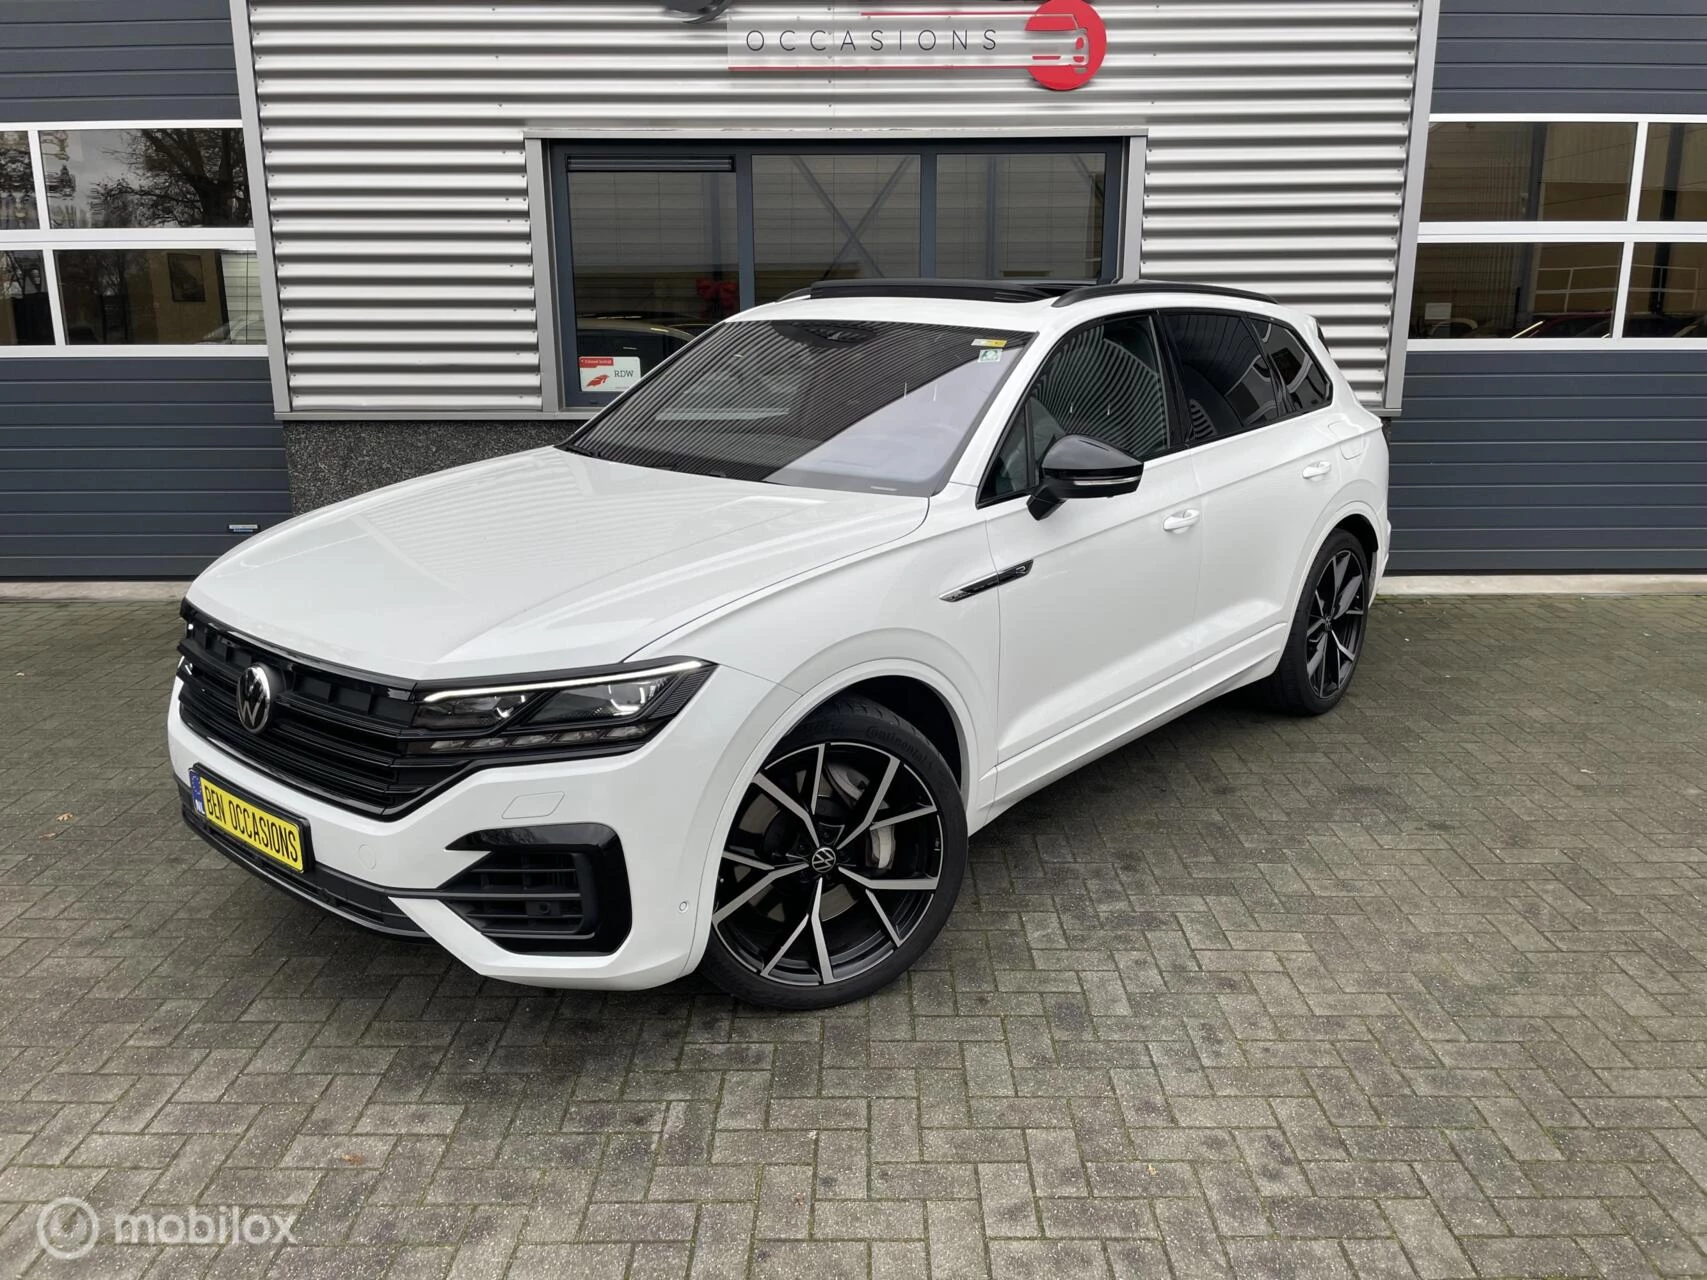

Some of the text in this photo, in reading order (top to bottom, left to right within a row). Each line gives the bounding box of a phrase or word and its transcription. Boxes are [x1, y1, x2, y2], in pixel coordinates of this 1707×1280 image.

[745, 28, 998, 52] OCCASIONS
[614, 369, 634, 378] RDW
[204, 785, 299, 863] BEN OCCASIONS
